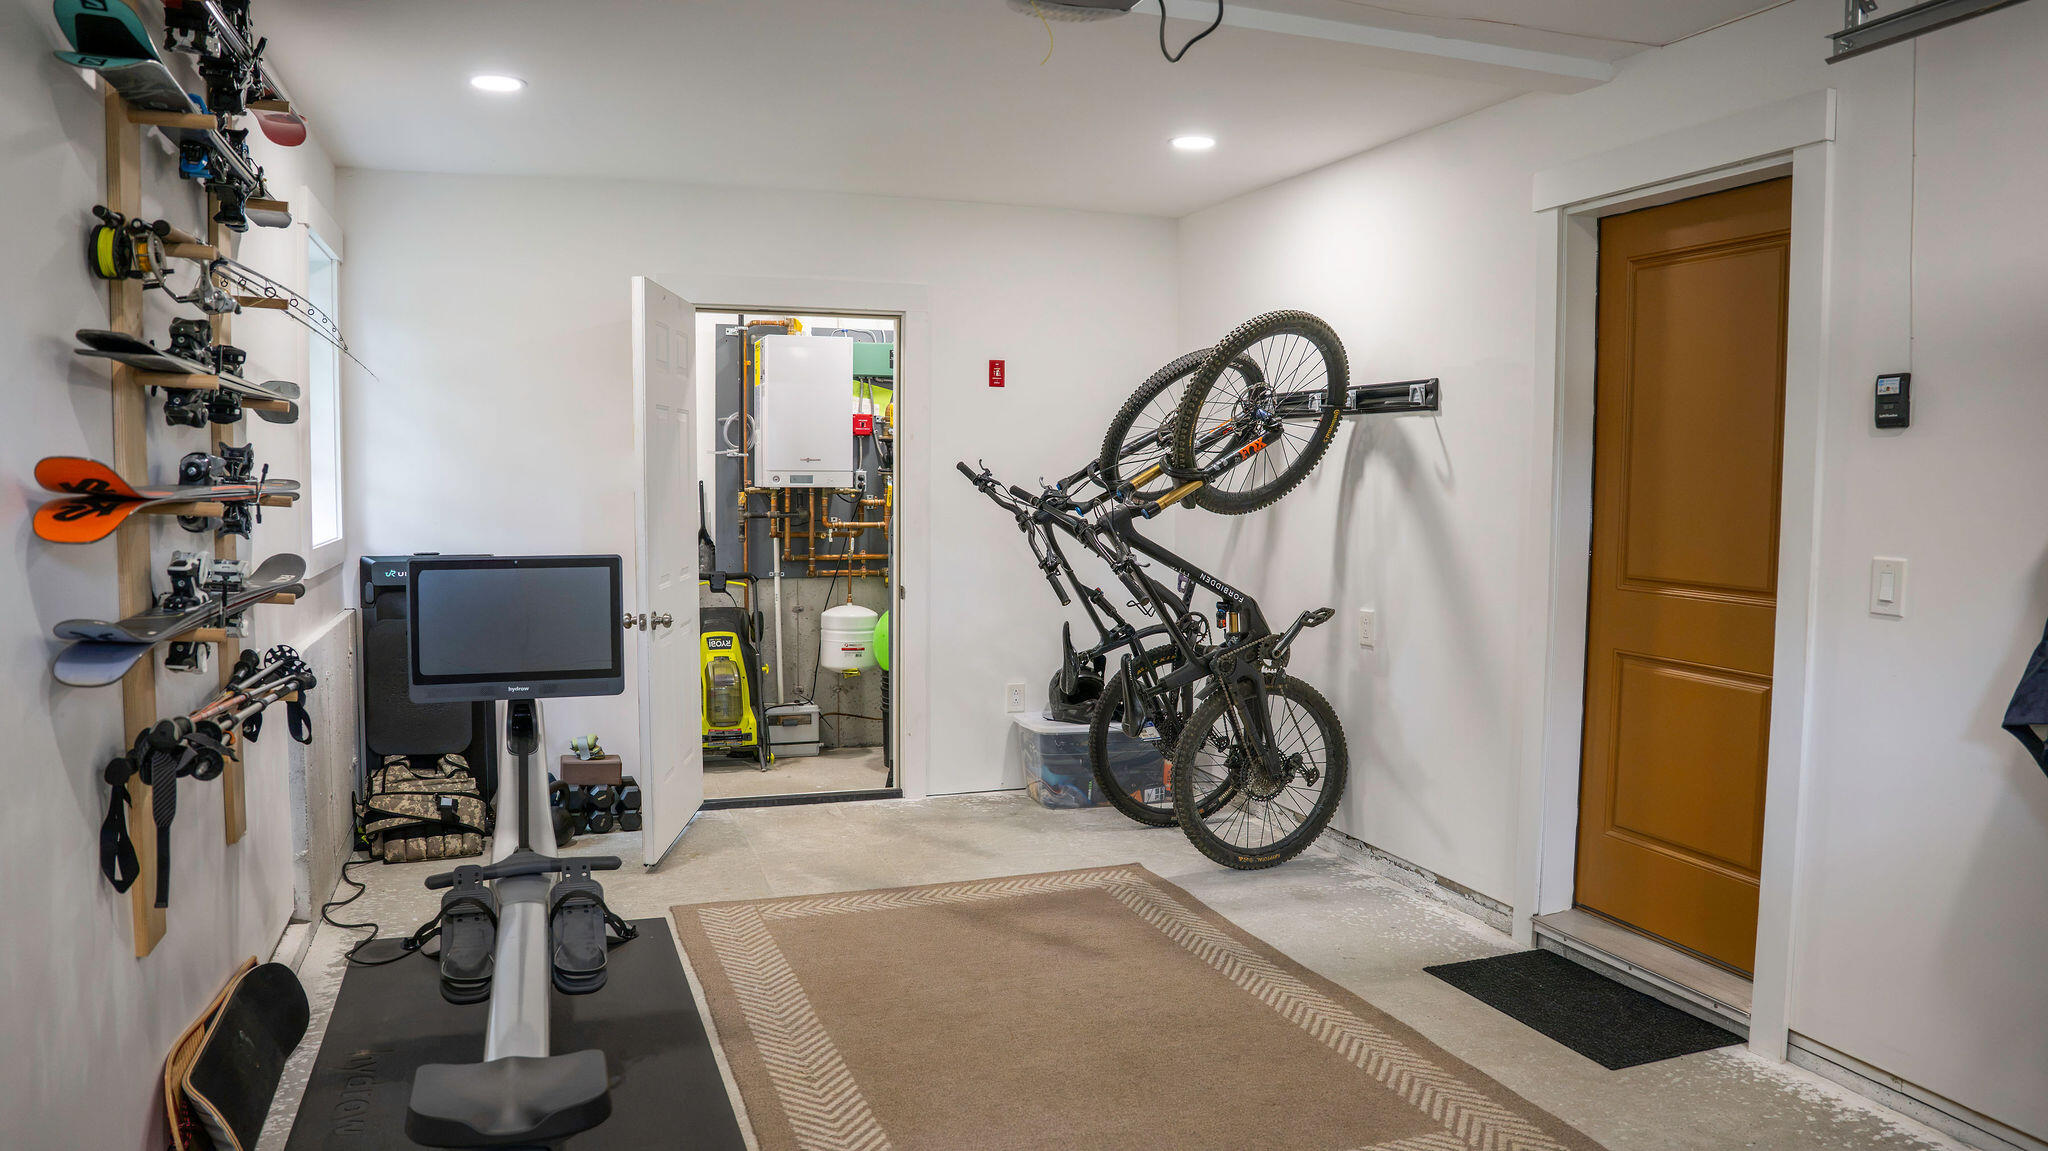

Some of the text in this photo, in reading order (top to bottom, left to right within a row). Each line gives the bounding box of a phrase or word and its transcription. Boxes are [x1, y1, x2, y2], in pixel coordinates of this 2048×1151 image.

[1241, 436, 1268, 462] FOX
[1200, 572, 1245, 603] FORBIDDEN
[708, 640, 732, 648] RYOBI
